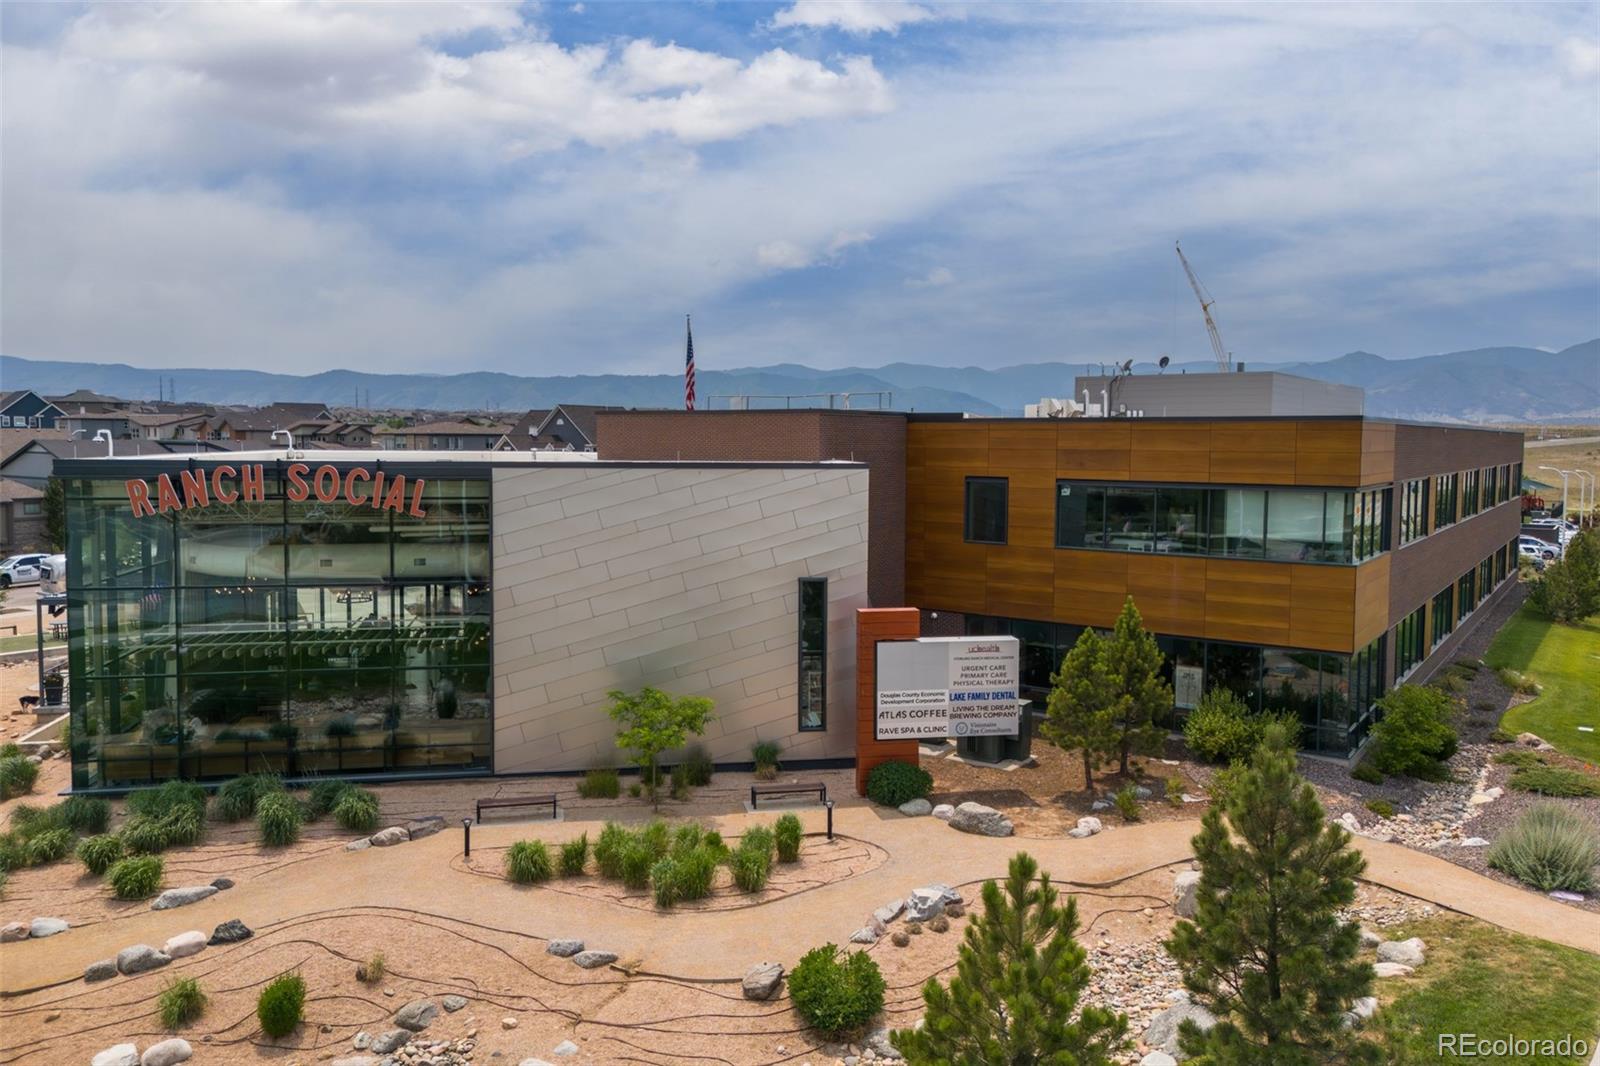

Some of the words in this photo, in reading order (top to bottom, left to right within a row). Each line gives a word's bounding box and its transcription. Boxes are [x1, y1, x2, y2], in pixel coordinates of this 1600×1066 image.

[124, 463, 265, 518] RANCH
[286, 463, 426, 518] SOCIAL
[968, 644, 1000, 653] uchealth
[949, 692, 966, 701] LAKE
[968, 692, 991, 700] FAMILY
[992, 691, 1016, 700] DENTAL
[879, 710, 908, 719] ATLAS
[909, 709, 948, 718] COFFEE
